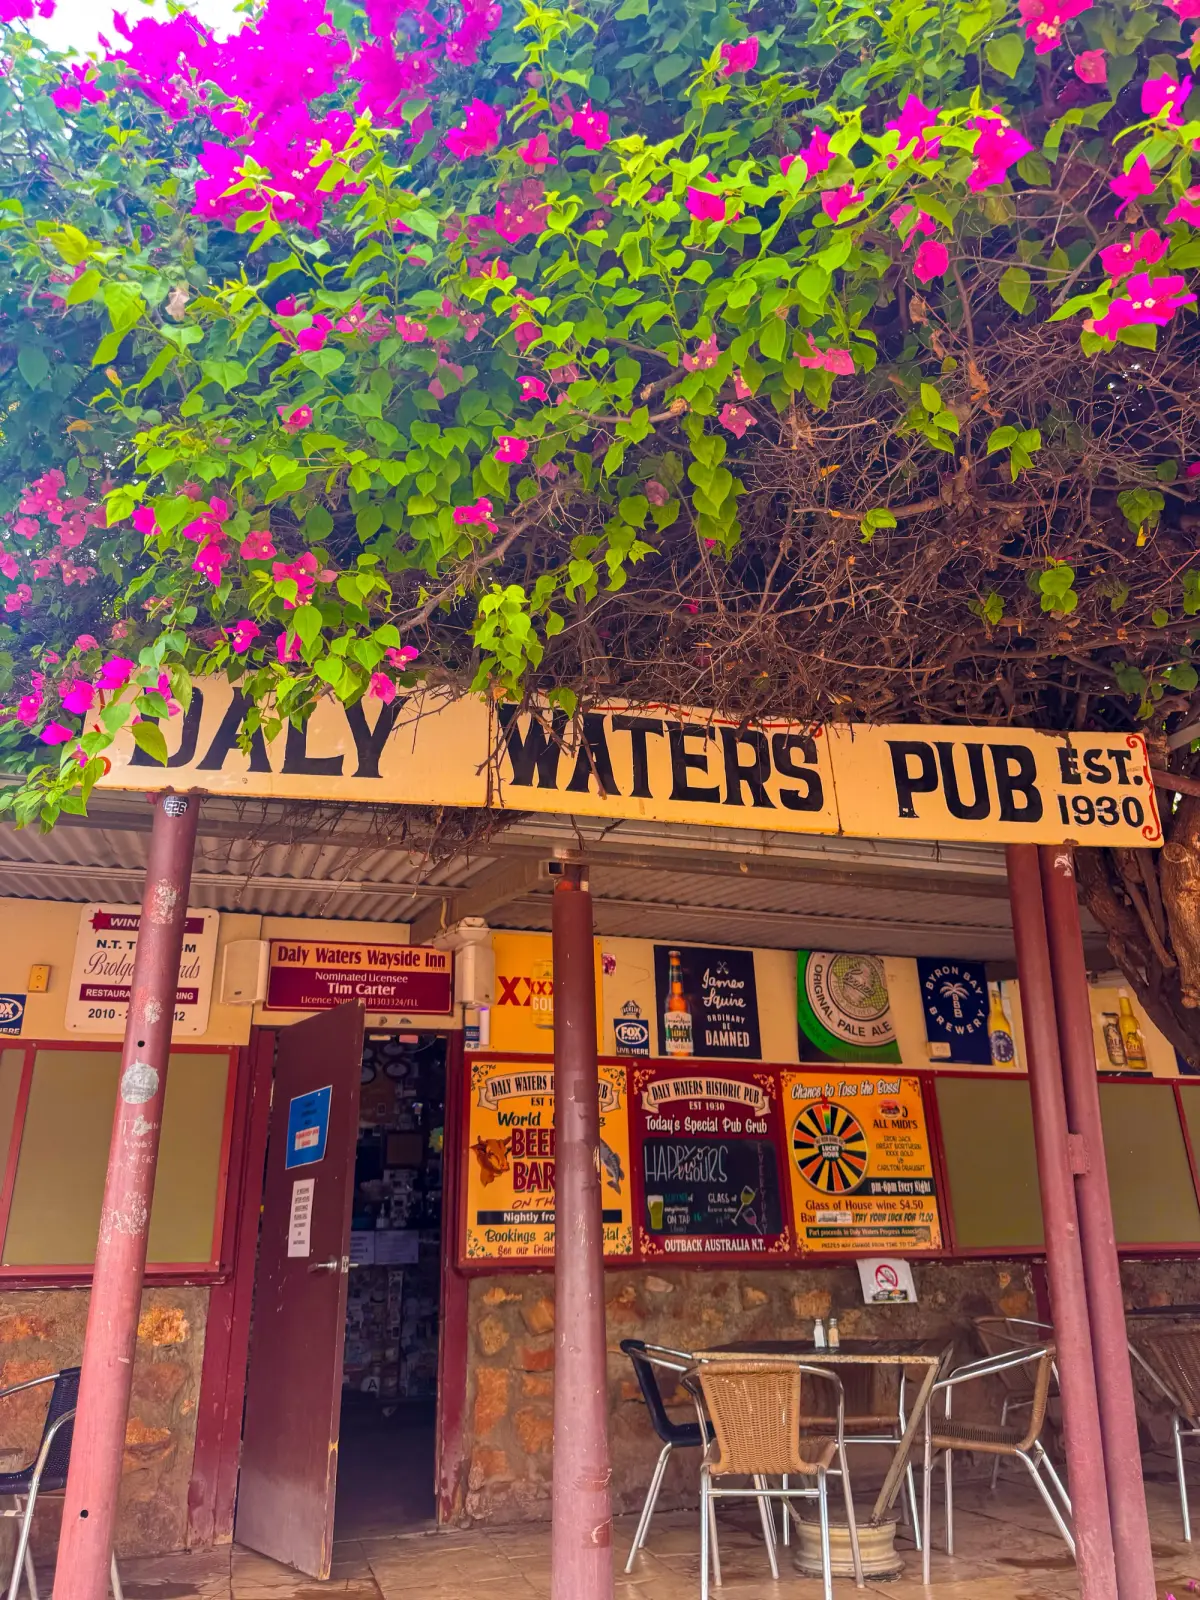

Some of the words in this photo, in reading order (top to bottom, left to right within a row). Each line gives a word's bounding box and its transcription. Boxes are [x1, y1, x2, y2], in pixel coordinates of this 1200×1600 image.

[127, 686, 411, 778] DALY
[499, 702, 823, 812] WATERS
[884, 740, 1043, 823] PUB
[1056, 747, 1144, 785] EST.
[164, 801, 188, 815] 526
[1057, 794, 1145, 828] 1930
[96, 939, 122, 950] N.T.
[277, 946, 309, 965] Daly
[316, 948, 361, 965] Waters
[367, 950, 421, 969] Wayside
[425, 952, 446, 968] Inn
[315, 972, 366, 982] Nominated
[369, 973, 408, 983] Licensee
[702, 968, 745, 989] James
[925, 966, 959, 990] BYRON
[963, 972, 983, 994] BAY
[327, 983, 352, 994] Tim
[355, 984, 396, 996] Carter
[301, 995, 331, 1004] Licence
[533, 996, 554, 1012] GOL
[702, 988, 746, 1009] Squire
[813, 964, 834, 1021] ORIGINAL
[837, 1018, 866, 1037] PALE
[871, 1021, 892, 1036] ALE
[88, 1009, 115, 1019] 2010
[707, 1014, 746, 1024] ORDINARY
[929, 1006, 985, 1035] BREWERY
[621, 1026, 642, 1039] FOX
[705, 1030, 750, 1048] DAMNED
[631, 1048, 649, 1056] HERE
[491, 1079, 510, 1097] DALY
[515, 1075, 547, 1091] WATERS
[651, 1083, 671, 1100] DALY
[673, 1080, 703, 1097] WATERS
[706, 1080, 741, 1100] HISTORIC
[744, 1088, 760, 1104] PUB
[791, 1083, 821, 1099] Chance
[824, 1083, 835, 1097] to
[838, 1082, 858, 1097] Toss
[860, 1080, 874, 1095] the
[877, 1078, 901, 1094] Boss!
[531, 1097, 544, 1106] EST
[689, 1101, 702, 1110] EST
[705, 1102, 725, 1111] 1930
[498, 1112, 541, 1126] World
[645, 1114, 680, 1134] Today's
[684, 1116, 718, 1134] Special
[722, 1117, 741, 1132] Pub
[745, 1118, 767, 1133] Grub
[873, 1119, 888, 1129] ALL
[891, 1119, 918, 1129] MIDI'S
[644, 1144, 697, 1182] HAPPY
[898, 1180, 913, 1194] Every
[914, 1180, 931, 1194] Night
[512, 1200, 531, 1209] ON
[534, 1198, 555, 1208] TH
[708, 1193, 729, 1204] GLASS
[806, 1199, 829, 1210] Glass
[833, 1199, 841, 1210] of
[846, 1199, 872, 1210] House
[876, 1200, 896, 1210] wine
[900, 1198, 924, 1211] $4.50
[503, 1211, 538, 1223] Nightly
[541, 1211, 555, 1222] fro
[667, 1214, 677, 1224] ON
[679, 1213, 690, 1225] TAP
[855, 1212, 867, 1222] TRY
[870, 1212, 886, 1222] YOUR
[888, 1212, 903, 1222] LUCK
[904, 1212, 916, 1222] FOR
[485, 1228, 536, 1244] Bookings
[516, 1247, 529, 1255] our
[665, 1239, 702, 1252] OUTBACK
[704, 1239, 750, 1251] AUSTRALIA
[752, 1238, 766, 1251] N.T.
